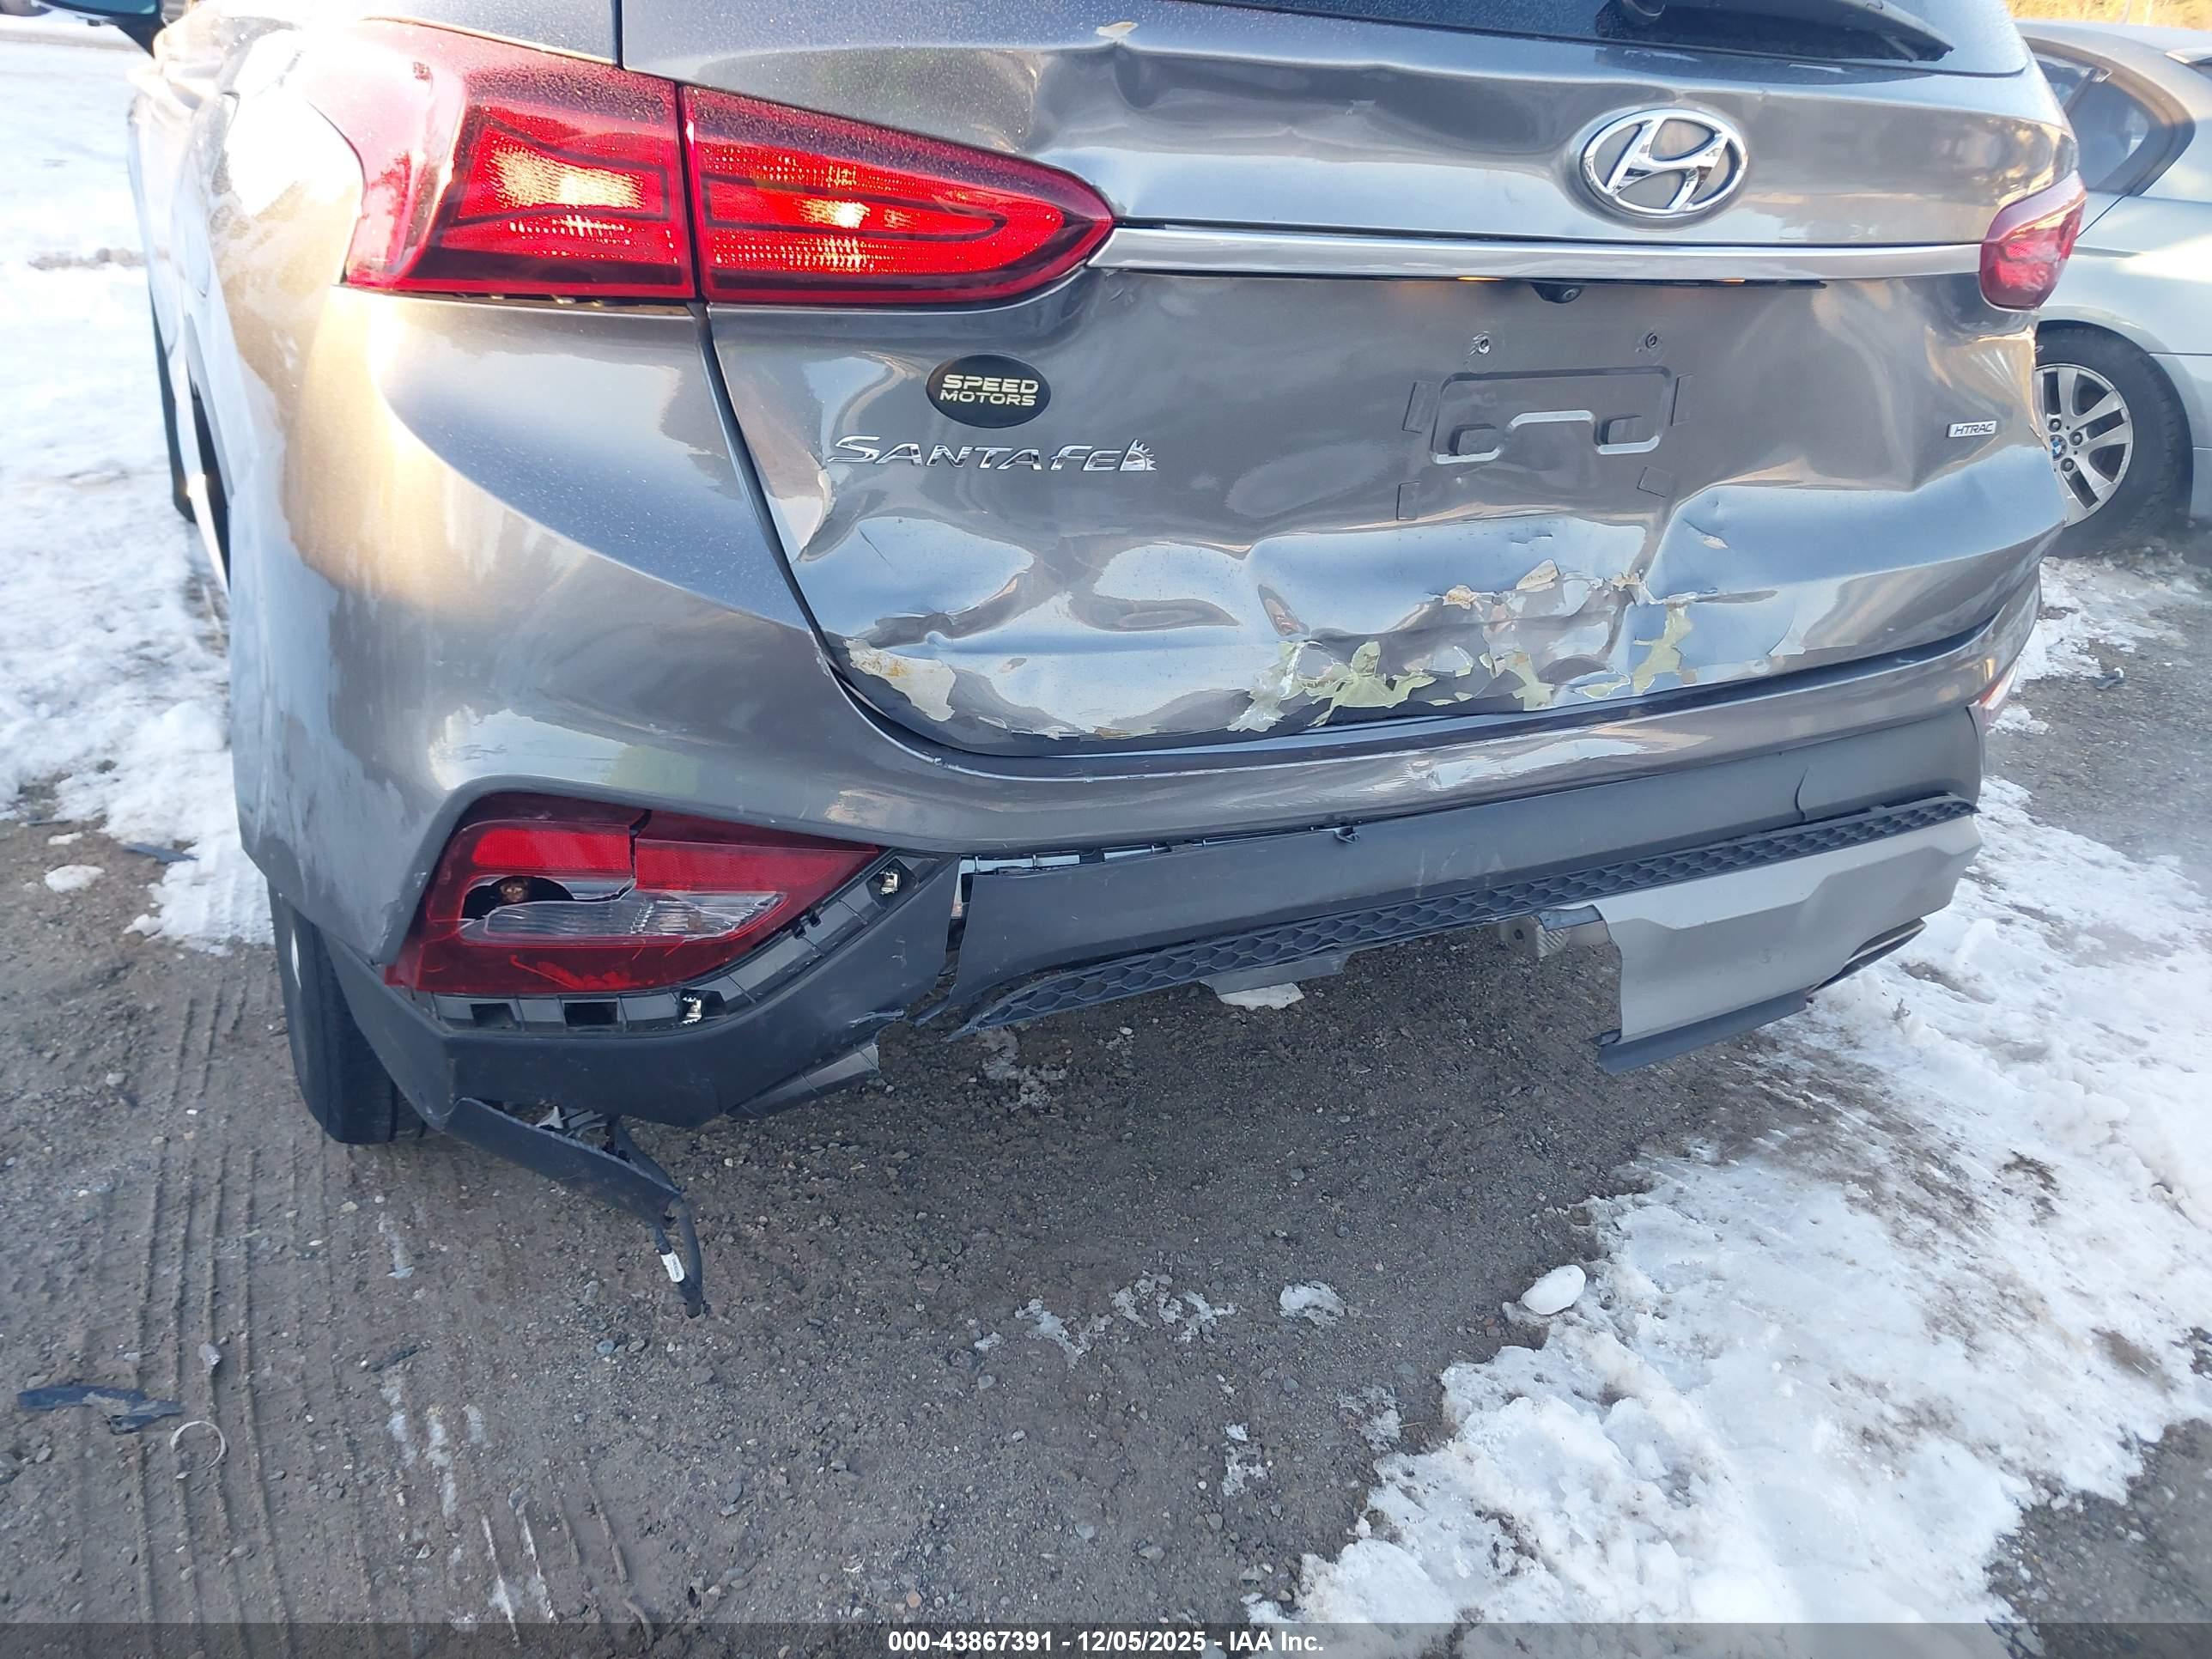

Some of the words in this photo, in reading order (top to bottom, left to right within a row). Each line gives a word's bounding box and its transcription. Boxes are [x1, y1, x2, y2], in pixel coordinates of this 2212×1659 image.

[942, 374, 1039, 394] SPEED
[939, 388, 1037, 406] MOTORS
[1954, 422, 1994, 435] HTRAC
